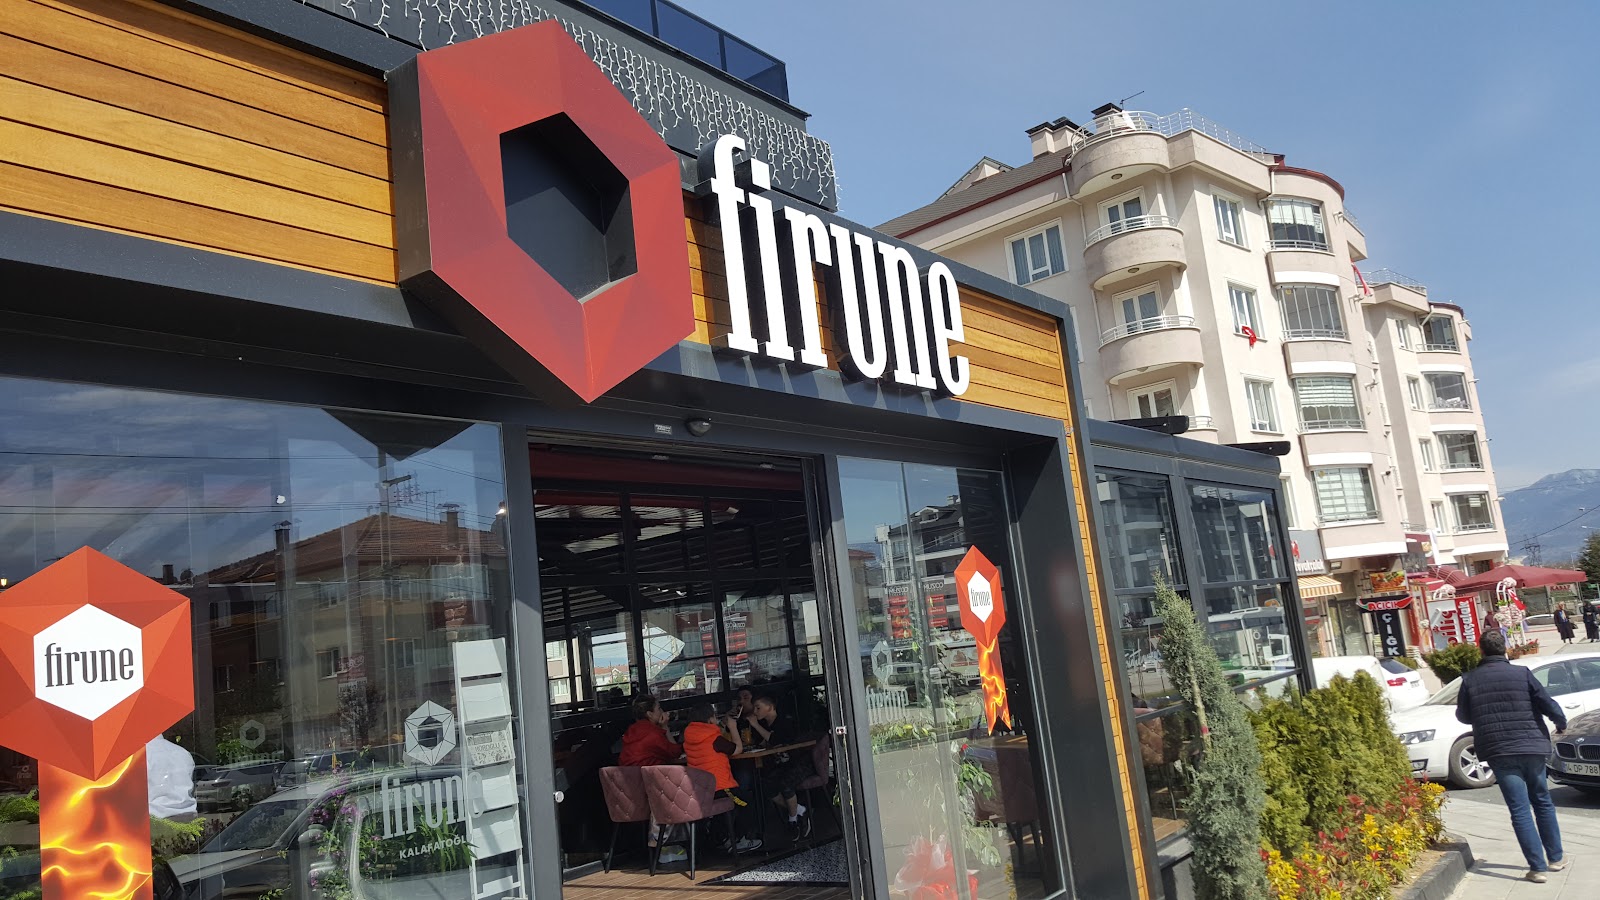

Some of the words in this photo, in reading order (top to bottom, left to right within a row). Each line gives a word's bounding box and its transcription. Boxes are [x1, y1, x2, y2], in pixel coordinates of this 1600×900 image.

[711, 134, 970, 395] firune
[45, 643, 134, 688] firune
[400, 834, 467, 860] KALAFATOĞL
